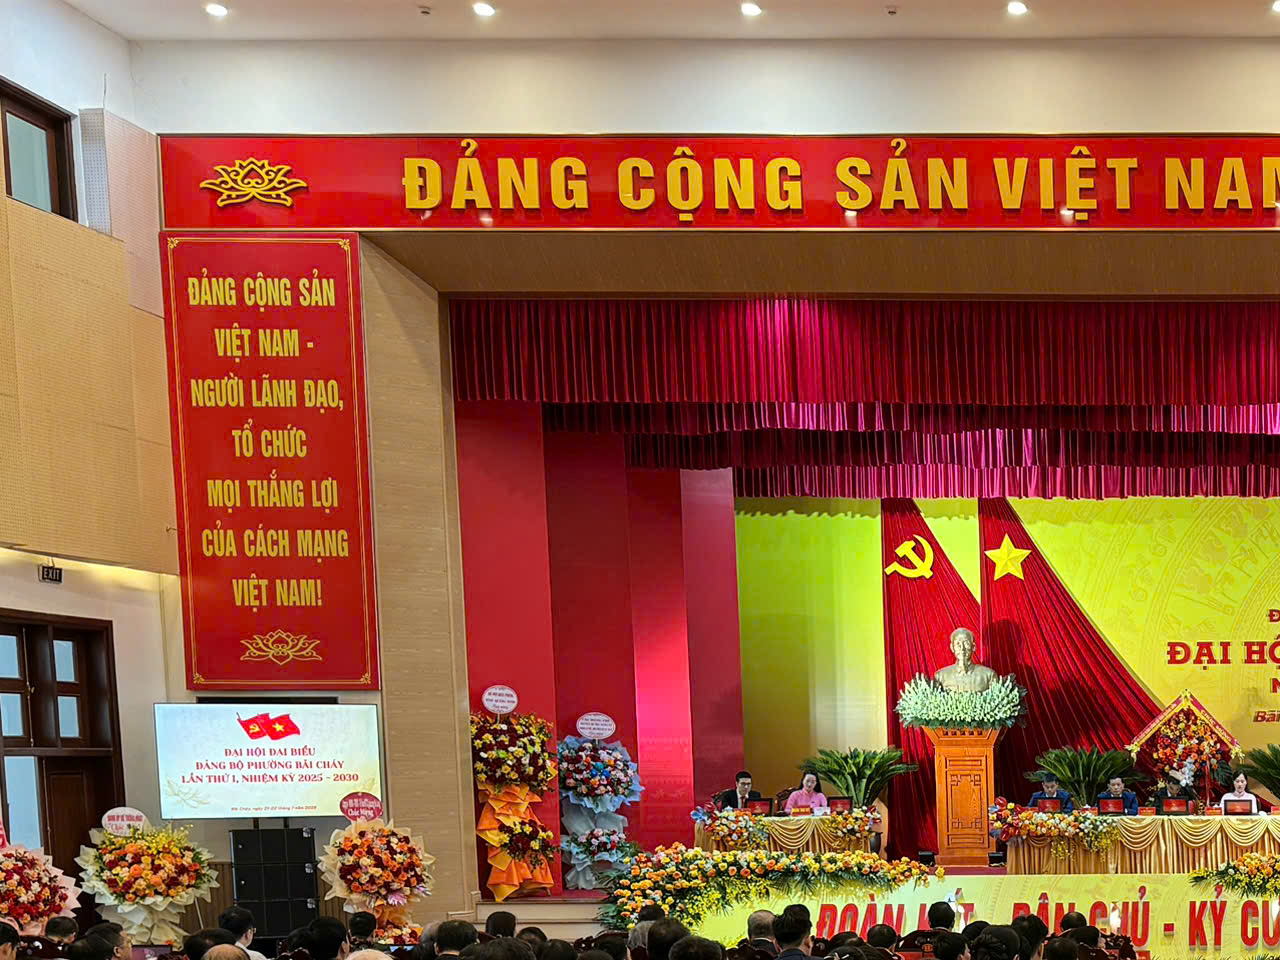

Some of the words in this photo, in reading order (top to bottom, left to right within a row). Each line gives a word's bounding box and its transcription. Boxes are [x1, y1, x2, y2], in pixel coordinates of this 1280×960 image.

[402, 138, 590, 211] ĐẢNG
[618, 145, 803, 222] CỘNG
[835, 138, 969, 211] SẢN
[994, 146, 1139, 221] VIỆT
[188, 268, 237, 306] ĐẢNG
[243, 271, 292, 312] CỘNG
[299, 268, 336, 306] SẢN
[214, 322, 251, 363] VIỆT
[258, 329, 299, 357] NAM
[190, 372, 244, 407] NGƯỜI
[251, 373, 297, 407] LÃNH
[303, 379, 344, 413] ĐẠO,
[232, 418, 254, 457] TỔ
[260, 423, 307, 457] CHỨC
[207, 479, 241, 513] MỌI
[247, 469, 305, 507] THẮNG
[311, 476, 338, 513] LỢI
[201, 520, 237, 557] CỦA
[243, 524, 290, 557] CÁCH
[297, 529, 349, 563] MẠNG
[43, 568, 61, 581] EXIT
[232, 573, 269, 612] VIỆT
[275, 579, 322, 606] NAM!
[1166, 642, 1232, 671] ĐẠI
[1253, 710, 1280, 723] Bãi
[196, 759, 226, 770] ĐẢNG
[229, 759, 244, 772] BỘ
[247, 759, 293, 770] PHƯỜNG
[295, 760, 313, 769] BÃI
[316, 759, 345, 769] CHÁY
[224, 748, 242, 758] ĐẠI
[246, 746, 265, 758] HỘI
[269, 748, 288, 758] ĐẠI
[291, 745, 315, 757] BIỂU
[181, 773, 203, 784] LẦN
[206, 773, 230, 784] THỨ
[232, 774, 239, 785] I,
[241, 773, 278, 785] NHIỆM
[281, 773, 296, 783] KỲ
[298, 773, 323, 783] 2025
[333, 773, 359, 782] 2030
[1189, 884, 1227, 946] KỶ
